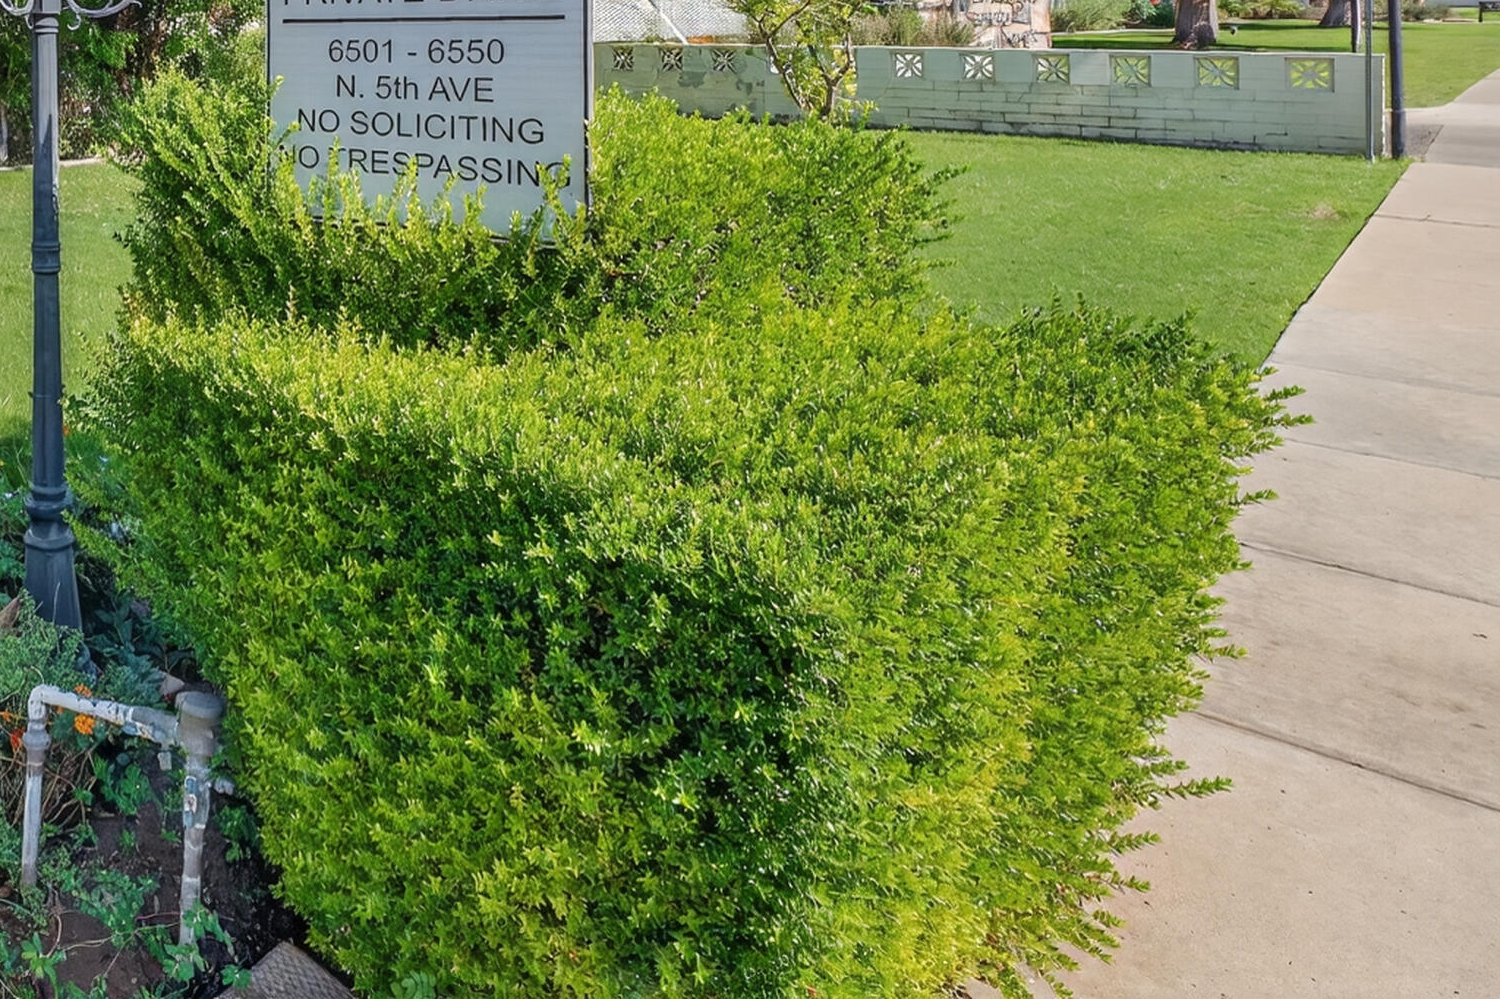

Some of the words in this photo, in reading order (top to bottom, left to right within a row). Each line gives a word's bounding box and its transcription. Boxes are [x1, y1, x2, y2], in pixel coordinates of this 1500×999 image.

[328, 39, 394, 64] 6501
[427, 39, 505, 64] 6550
[336, 74, 364, 99] N.
[375, 76, 419, 100] 5th
[428, 77, 495, 103] AVE
[298, 109, 340, 133] NO
[350, 110, 544, 145] SOLICITING
[279, 144, 320, 169] NO
